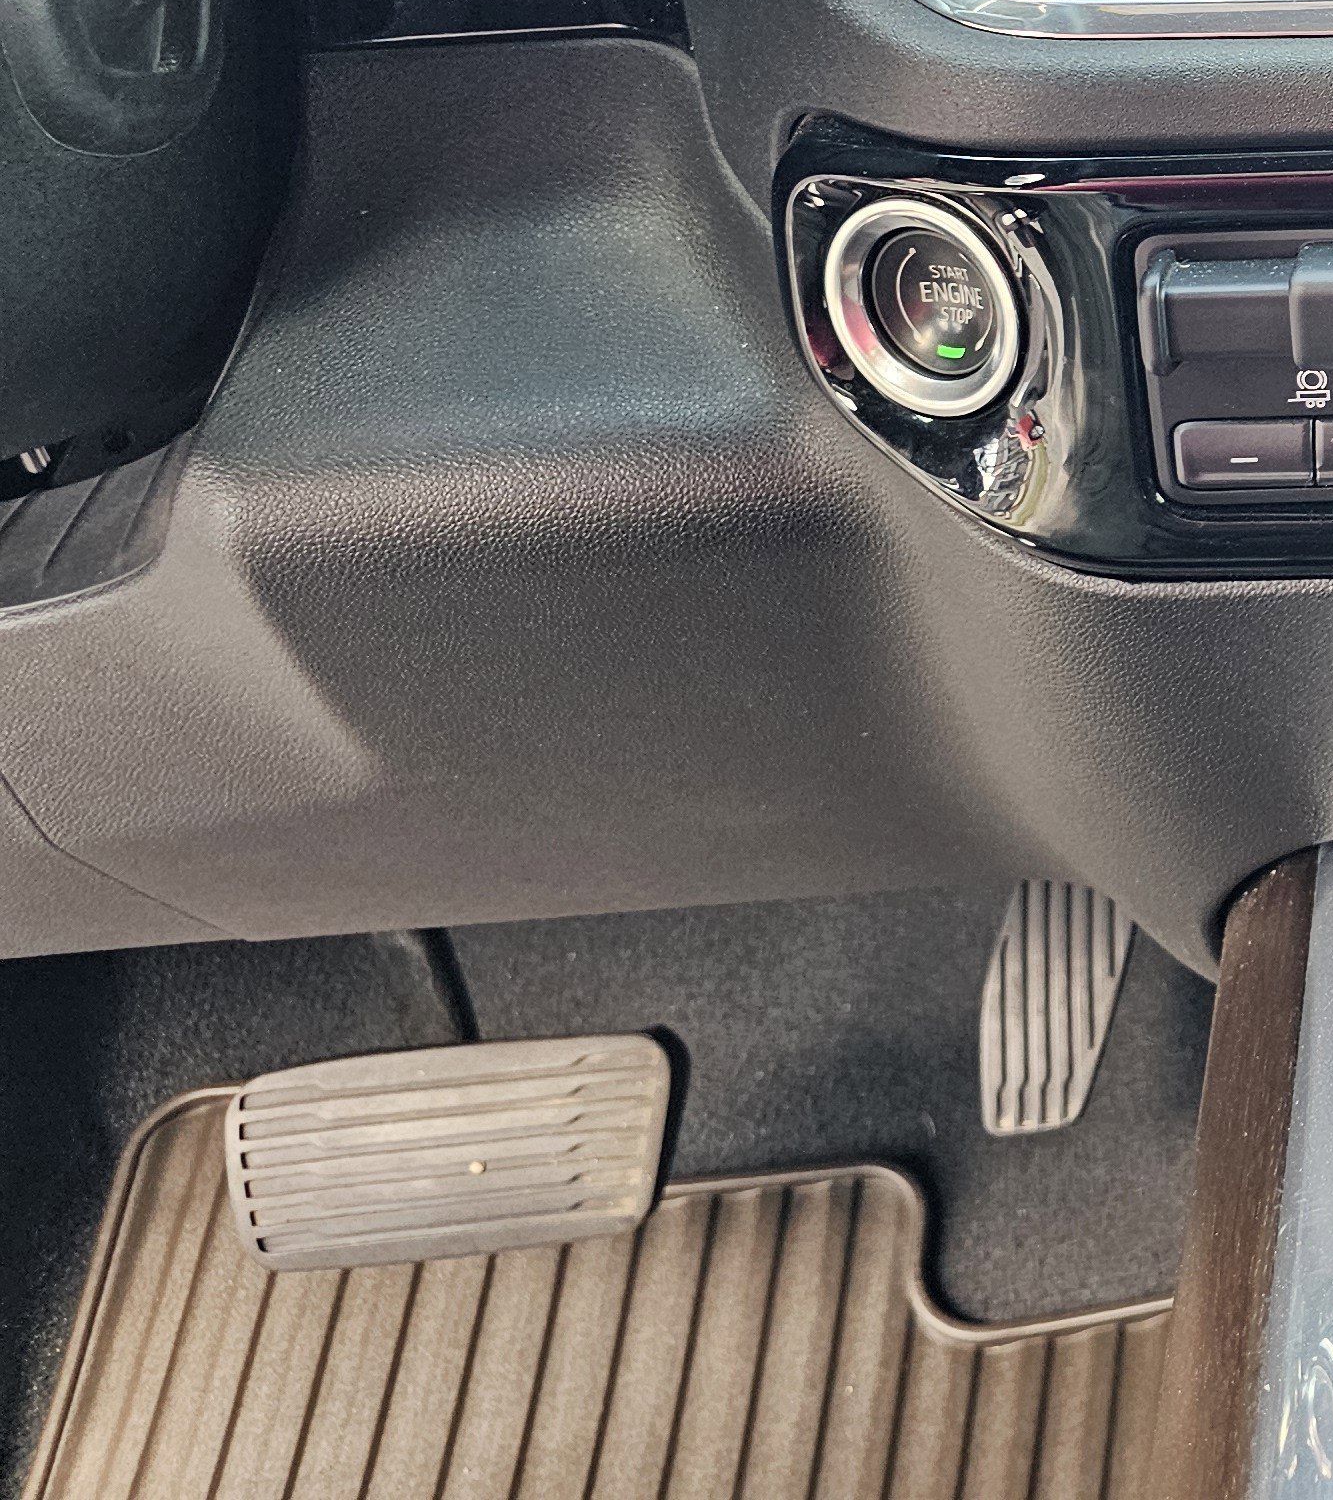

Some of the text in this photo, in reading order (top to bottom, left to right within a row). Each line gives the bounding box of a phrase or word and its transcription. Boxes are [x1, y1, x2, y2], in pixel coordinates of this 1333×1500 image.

[929, 265, 969, 280] START
[919, 281, 984, 310] ENGINE
[940, 306, 974, 324] STOP
